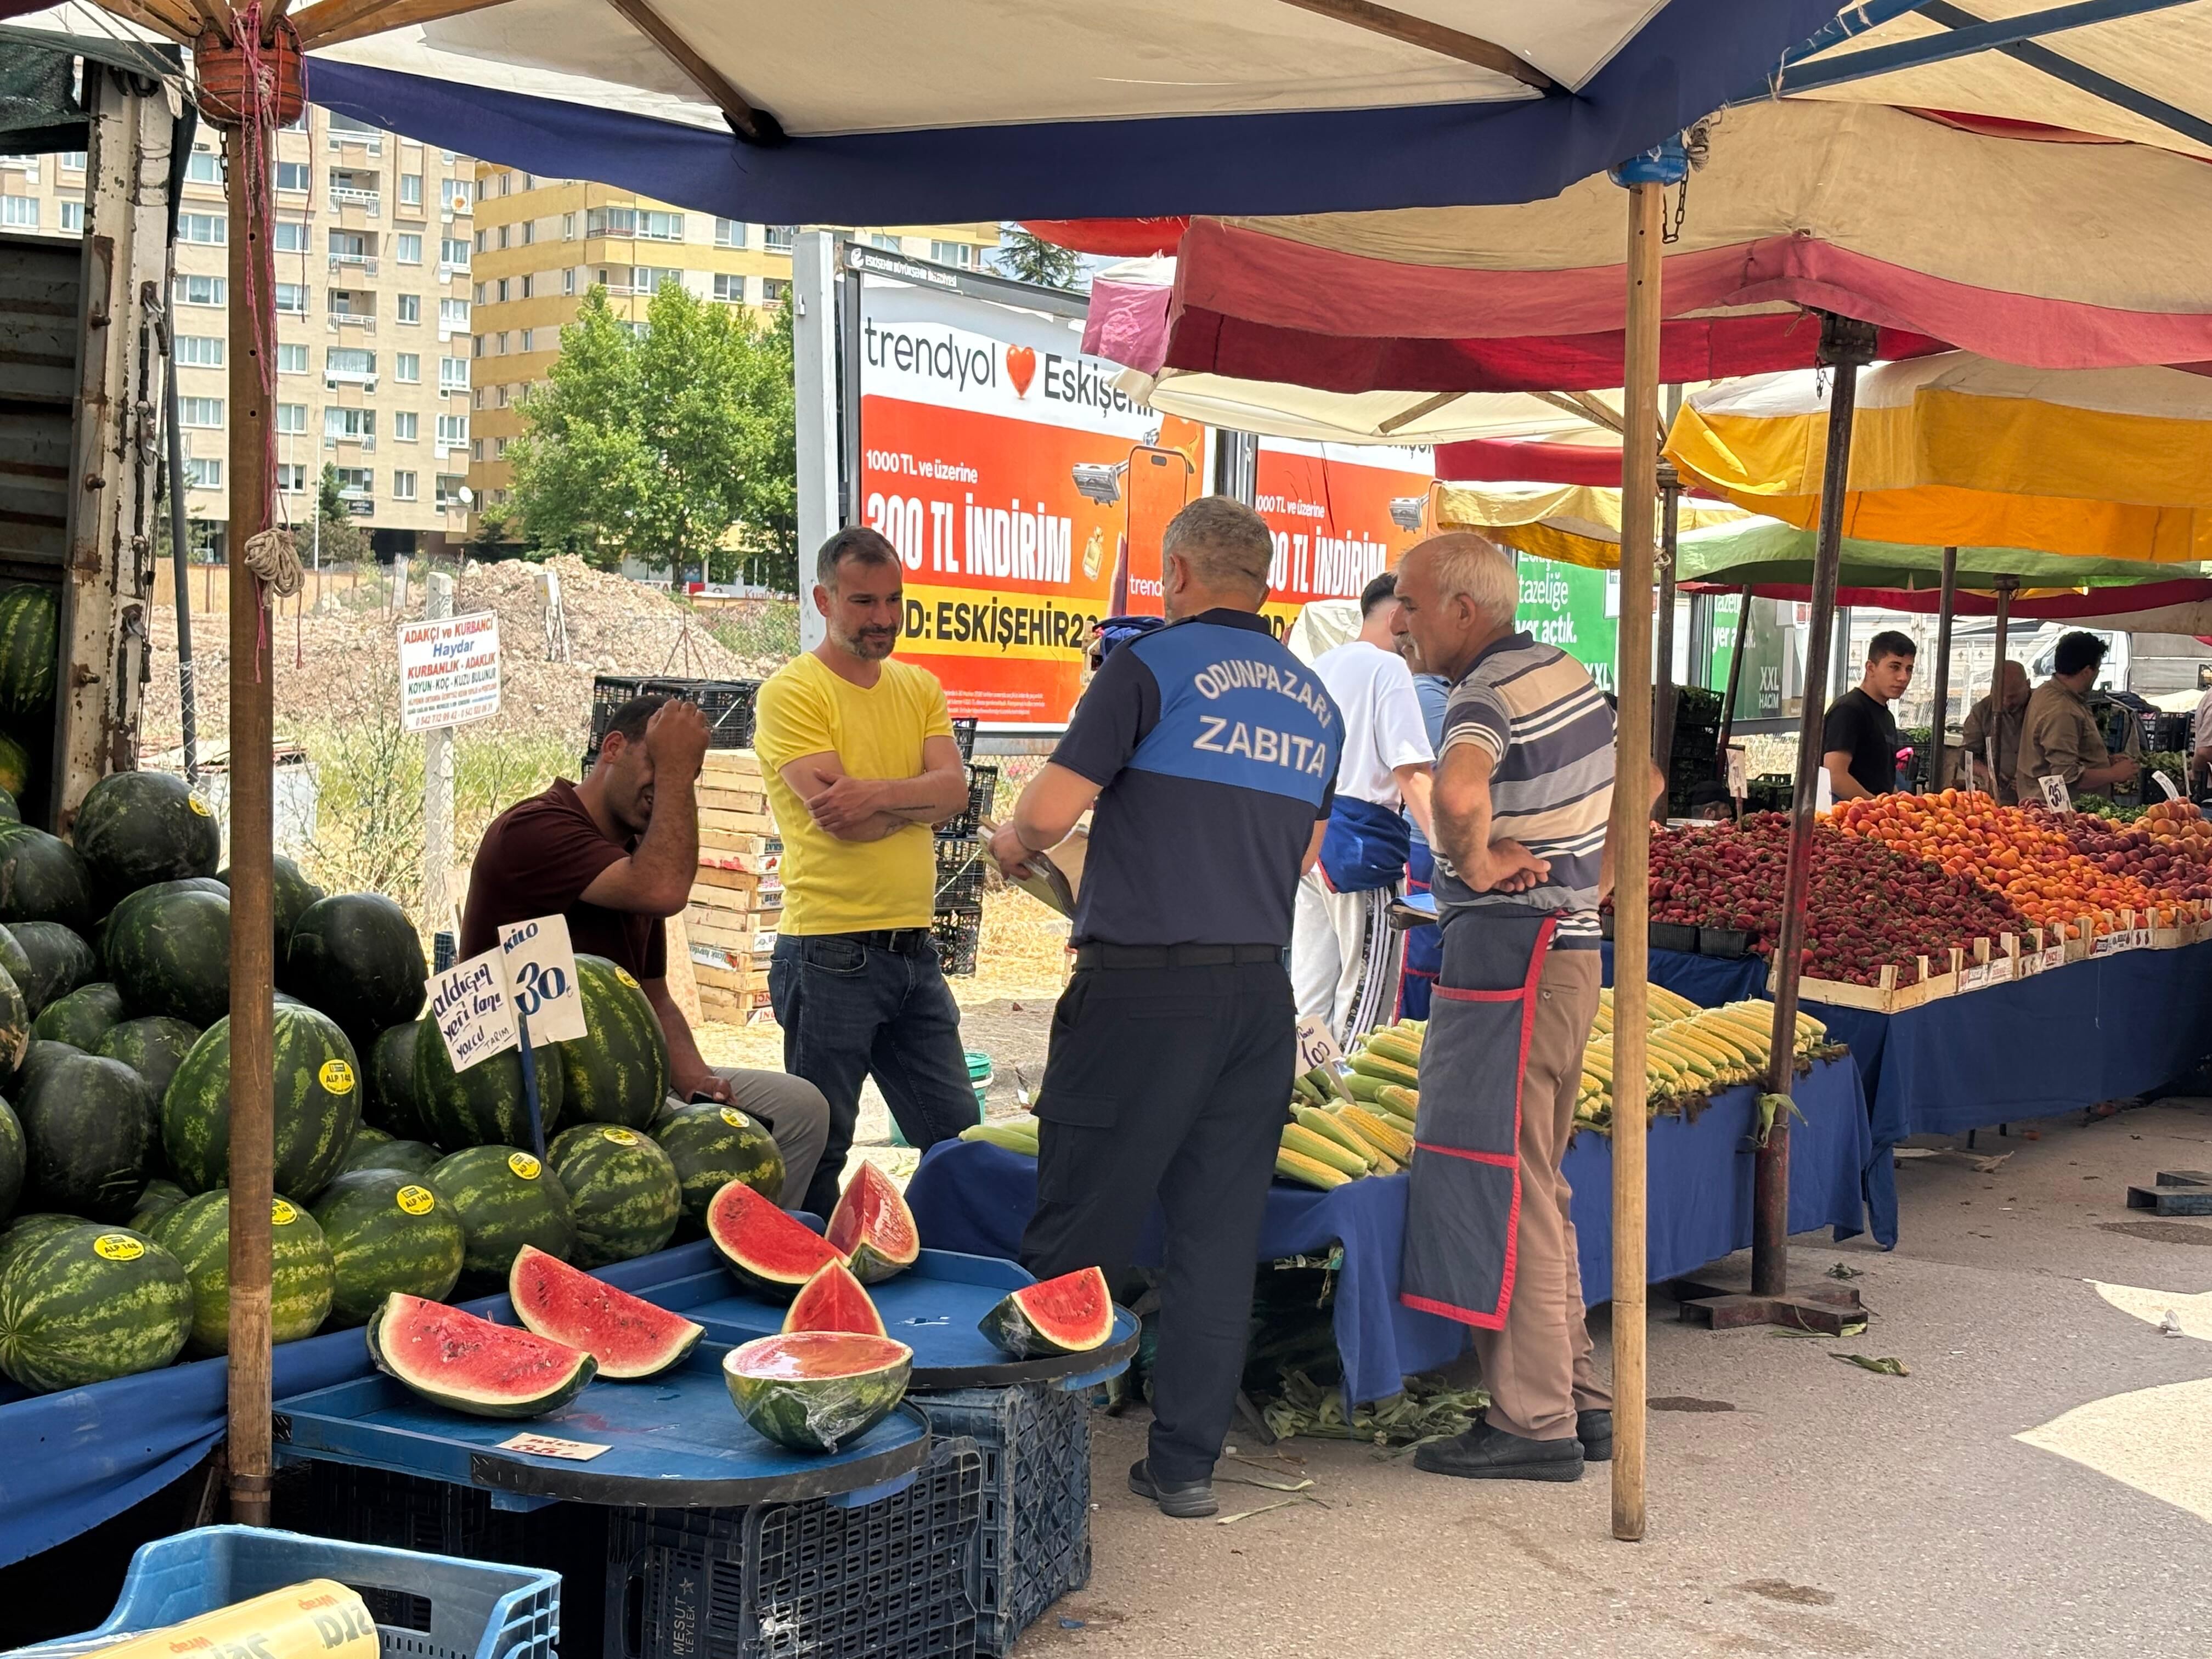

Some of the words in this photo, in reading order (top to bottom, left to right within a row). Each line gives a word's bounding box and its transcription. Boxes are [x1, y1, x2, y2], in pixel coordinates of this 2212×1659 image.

[865, 317, 995, 392] trendyol
[1045, 353, 1153, 418] Eskişe
[866, 449, 900, 472] 1000
[901, 454, 917, 476] TL
[918, 462, 933, 478] ve
[934, 459, 978, 484] üzerine
[1276, 496, 1286, 514] TL
[1287, 500, 1296, 515] ve
[1297, 498, 1325, 518] üzerine
[930, 500, 959, 573] TL
[966, 492, 1071, 584] İNDİRİM
[1293, 533, 1309, 593] TL
[1313, 525, 1387, 597] İNDİRİM
[1518, 572, 1568, 612] tazeliğe
[403, 627, 439, 645] ADAKÇI
[442, 628, 452, 639] ve
[454, 617, 493, 637] KURBANCI
[1541, 612, 1577, 646] açtık.
[433, 639, 475, 659] Haydar
[408, 659, 459, 680] KURBANLIK
[465, 652, 496, 670] ADAKLIK
[408, 680, 432, 696] KOYUN
[435, 676, 450, 692] KOÇ
[454, 673, 470, 687] KUZU
[471, 667, 496, 684] BULUNUR
[1759, 666, 1780, 691] XXL
[1193, 714, 1326, 778] ZABITA
[504, 922, 539, 955] KİLO
[515, 961, 567, 1016] 30
[484, 1027, 510, 1049] TARIM
[299, 1594, 340, 1610] Wrap
[673, 1595, 686, 1656] MESUT
[686, 1605, 696, 1654] LEYLEK
[169, 1636, 214, 1654] Wrap
